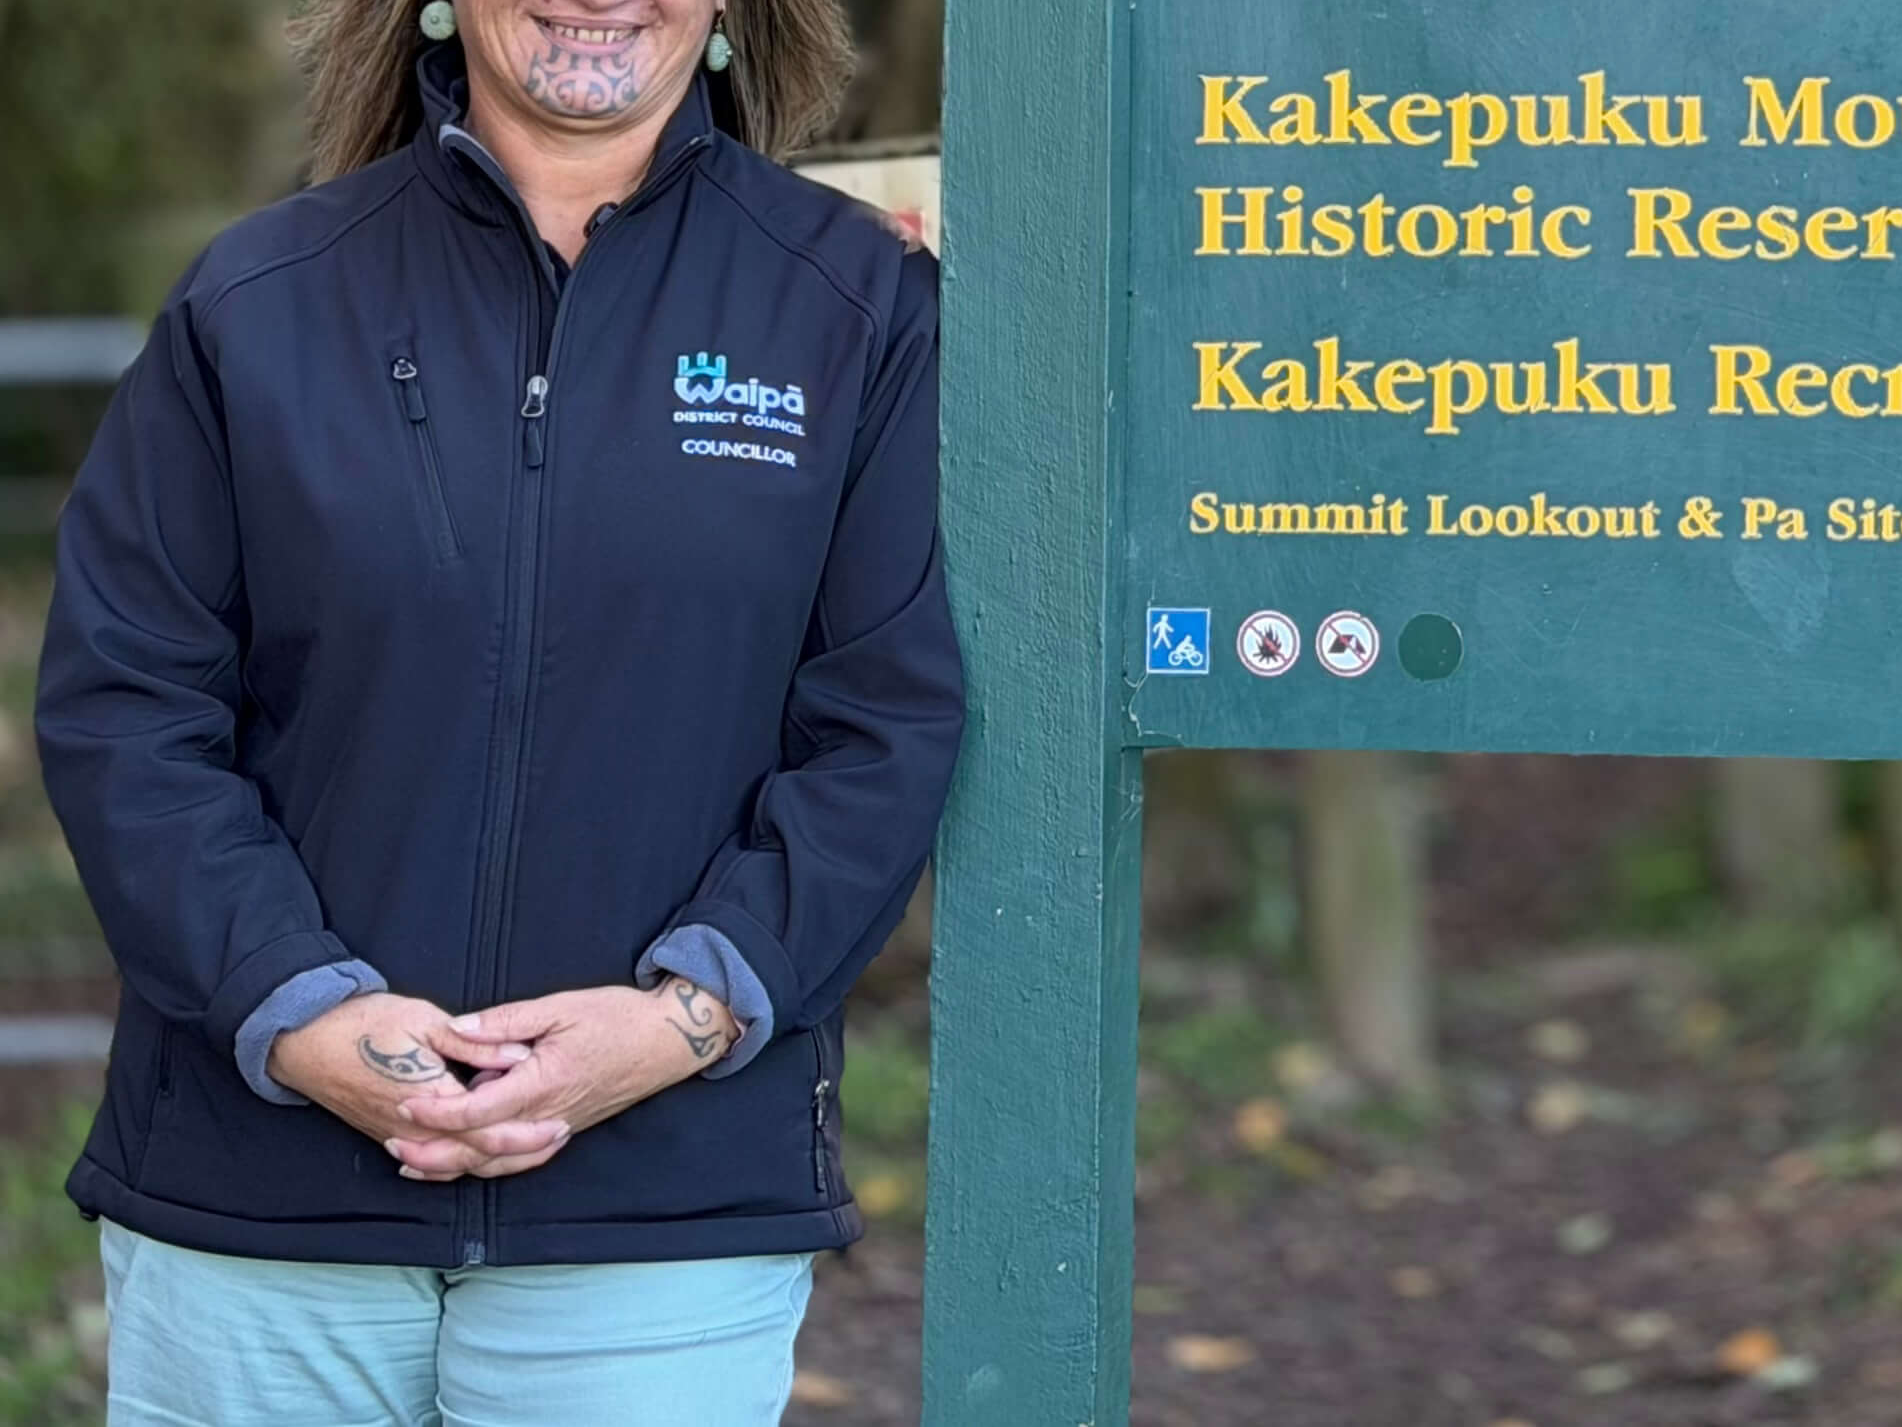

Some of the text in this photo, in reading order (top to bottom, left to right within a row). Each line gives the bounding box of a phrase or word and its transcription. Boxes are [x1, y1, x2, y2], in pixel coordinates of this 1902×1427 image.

[1194, 69, 1707, 168] Kakepuku
[1194, 185, 1592, 260] Historic
[674, 377, 805, 416] Waipā
[1193, 337, 1677, 435] Kakepuku
[673, 411, 806, 437] DISTRICT COUNCIL
[681, 439, 797, 467] COUNCILLOR
[1190, 492, 1409, 536] Summit
[1427, 492, 1661, 539] Lookout
[1677, 496, 1724, 539] &
[1741, 498, 1808, 541] Pa
